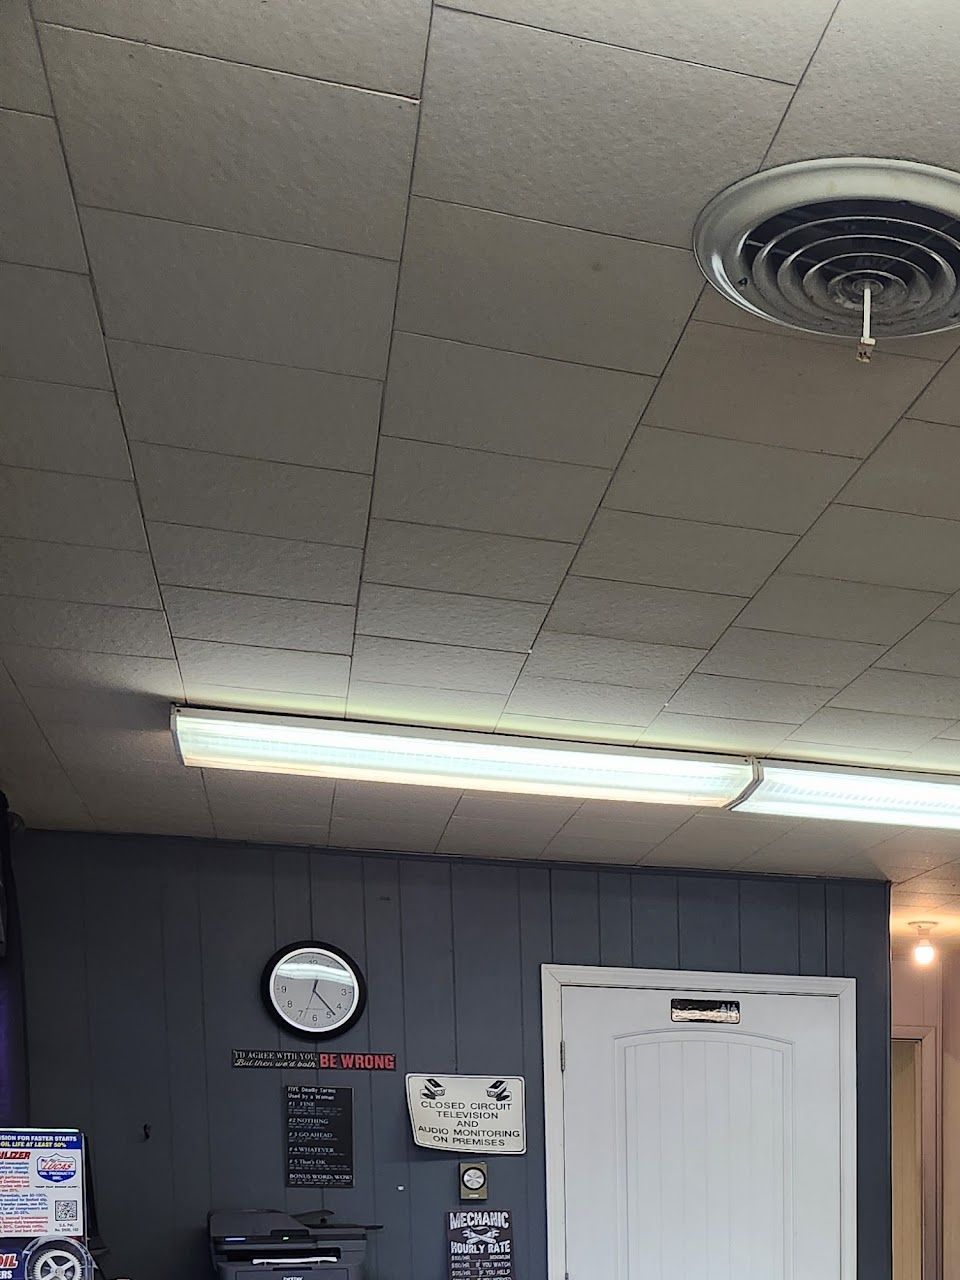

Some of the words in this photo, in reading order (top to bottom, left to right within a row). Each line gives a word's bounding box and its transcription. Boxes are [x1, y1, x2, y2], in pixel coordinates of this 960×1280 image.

[341, 988, 347, 996] 3
[287, 1000, 292, 1008] 8
[254, 1059, 273, 1067] then
[320, 1053, 338, 1068] BE
[340, 1054, 394, 1069] WRONG
[420, 1101, 466, 1110] CLOSED
[470, 1102, 512, 1110] CIRCUIT
[436, 1111, 498, 1119] TELEVISION
[456, 1120, 479, 1128] AND
[418, 1125, 449, 1135] AUDIO
[453, 1129, 520, 1137] MONITORING
[433, 1135, 448, 1143] ON
[452, 1138, 505, 1147] PREMISES
[449, 1211, 509, 1230] MECHANIC
[450, 1241, 485, 1254] HOURLY
[488, 1240, 511, 1254] RATE
